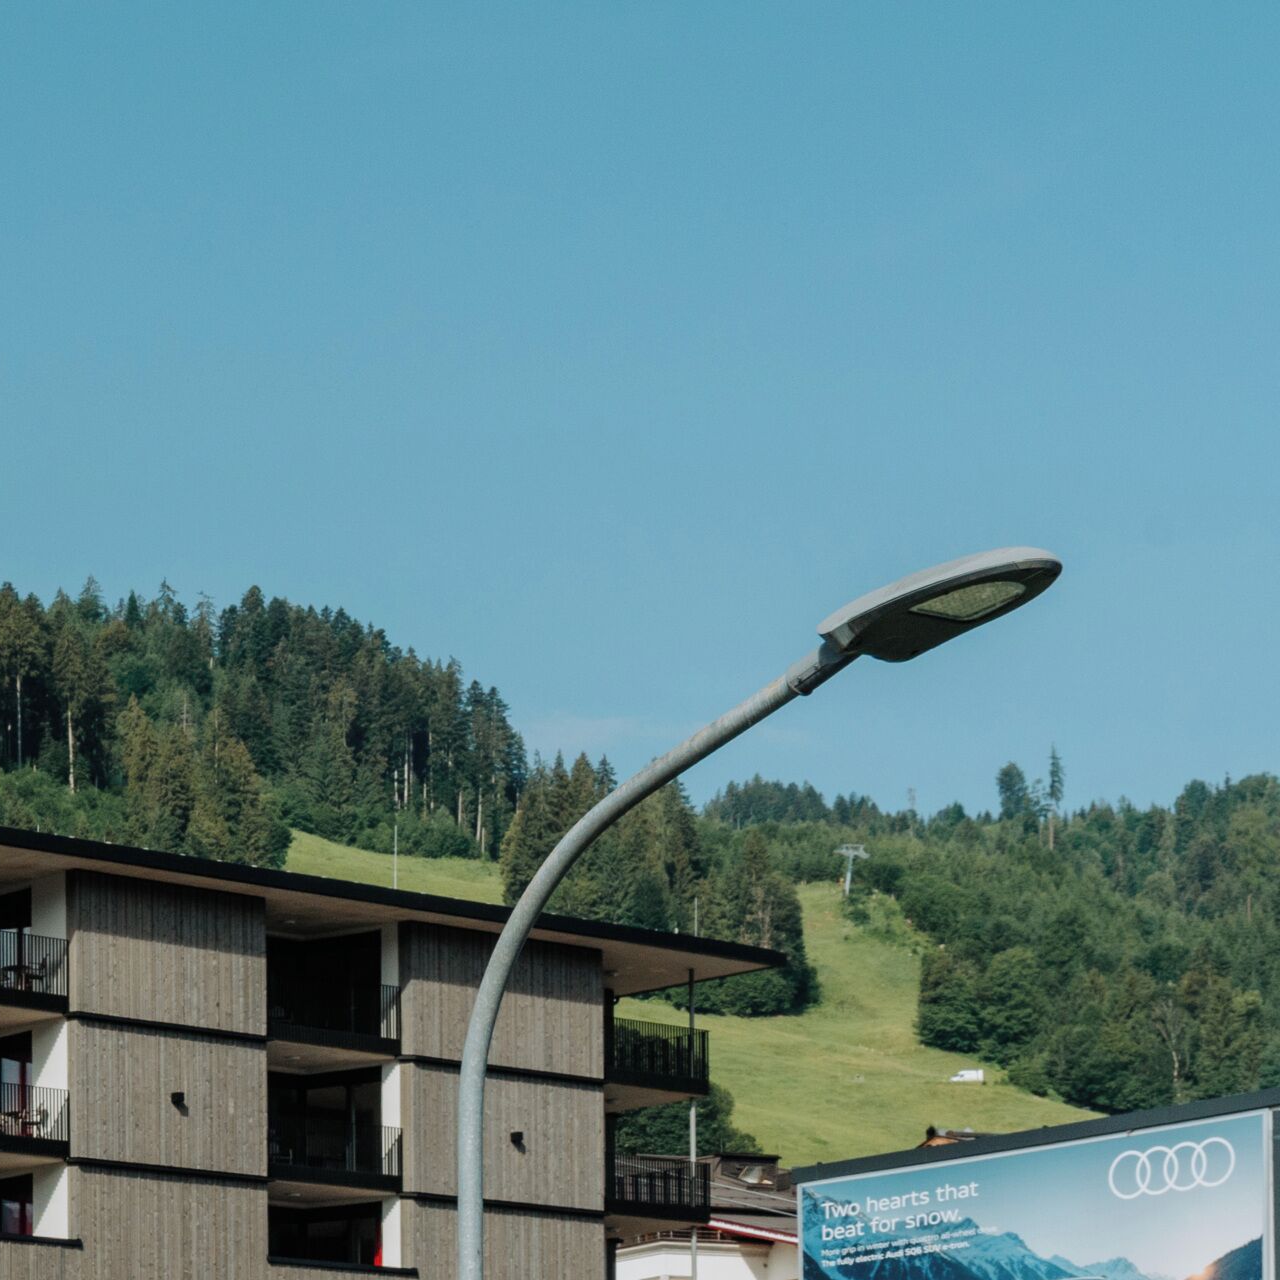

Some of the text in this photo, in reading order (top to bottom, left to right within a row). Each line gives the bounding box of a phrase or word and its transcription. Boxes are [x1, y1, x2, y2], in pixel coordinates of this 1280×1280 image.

[821, 1181, 980, 1220] Two hearts that
[821, 1208, 963, 1241] beat for snow.
[885, 1249, 904, 1260] Audi
